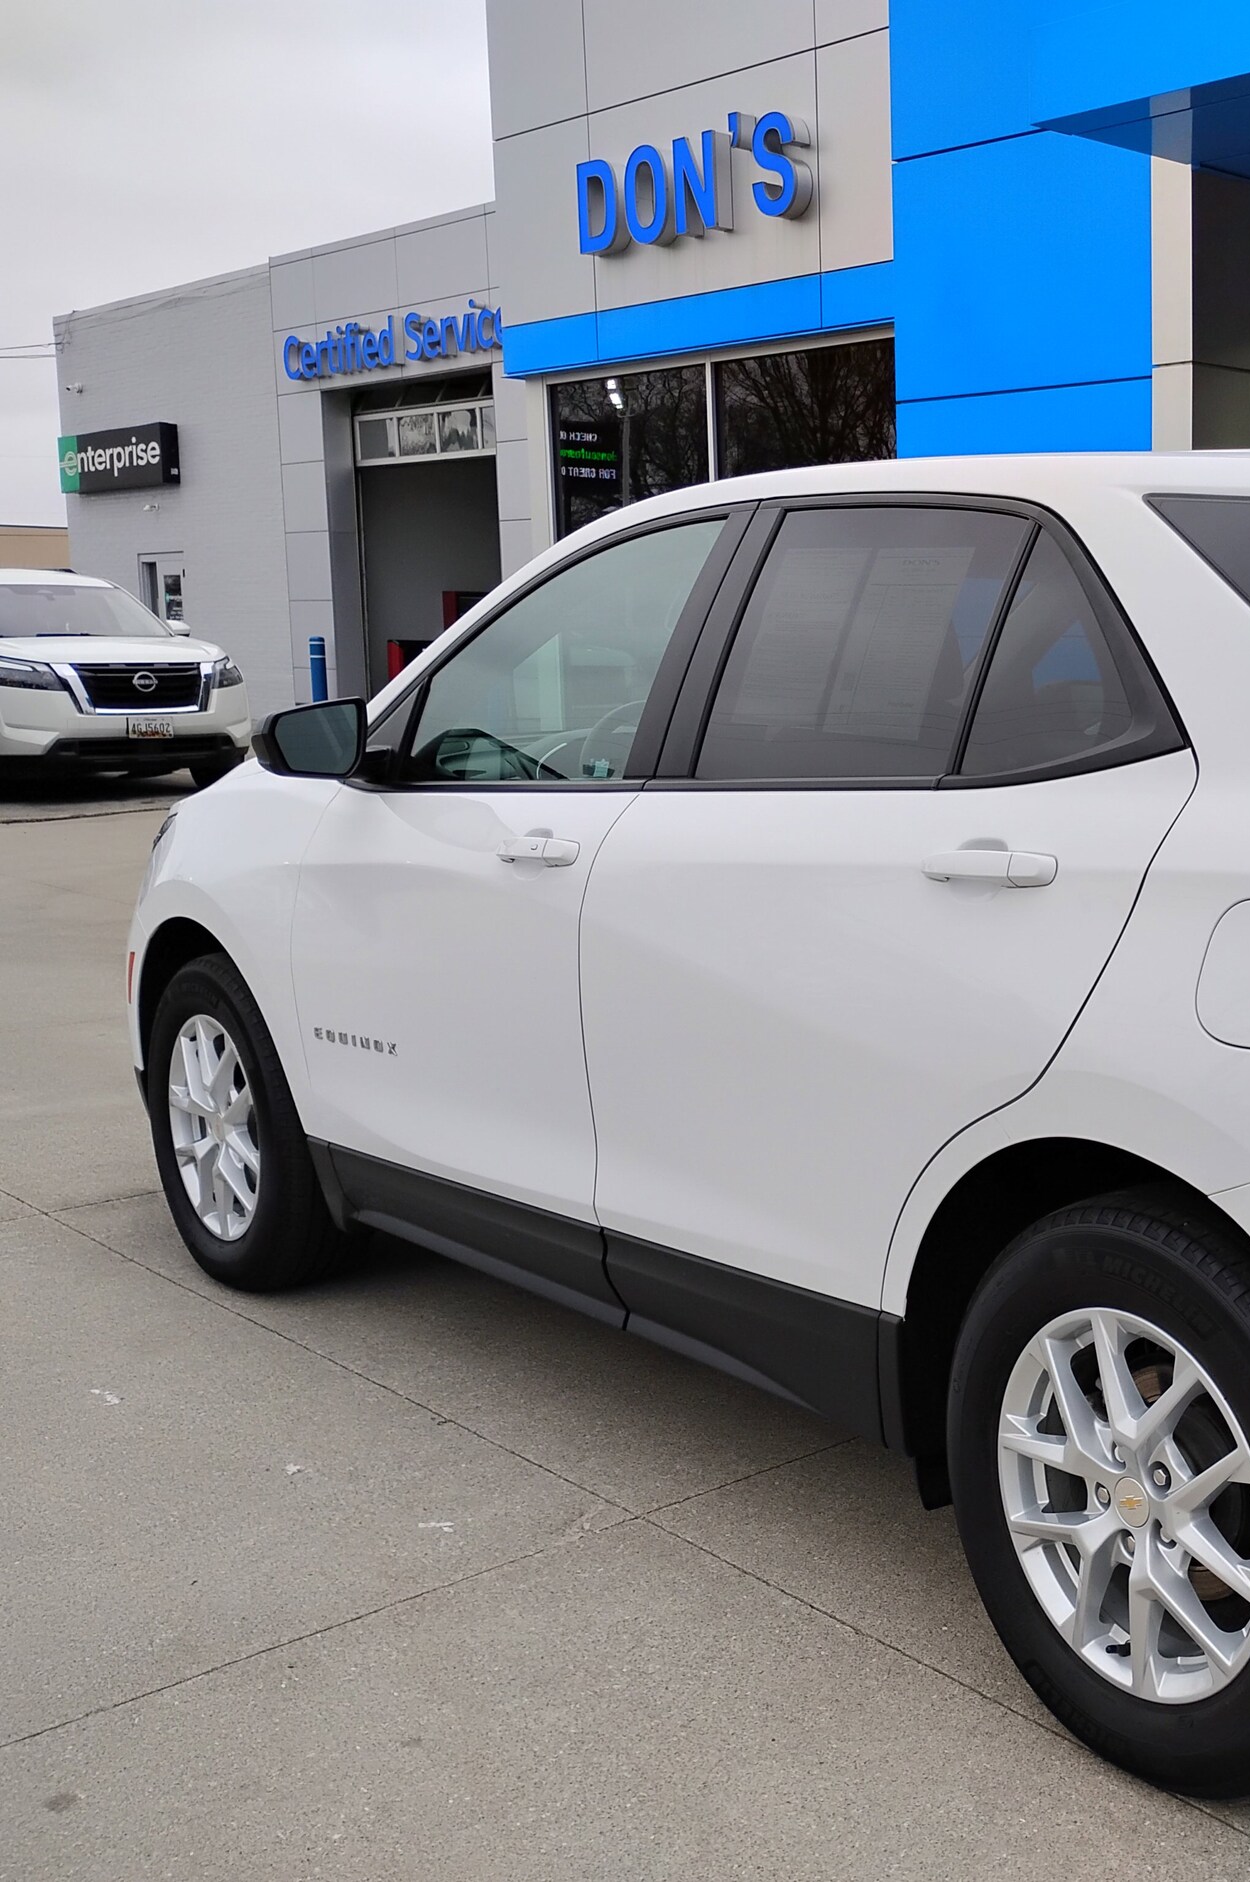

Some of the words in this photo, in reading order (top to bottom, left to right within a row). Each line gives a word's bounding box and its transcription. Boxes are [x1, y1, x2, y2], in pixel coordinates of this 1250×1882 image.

[577, 111, 803, 256] DON'S
[283, 315, 396, 381] Certified
[61, 436, 160, 477] enterprise
[314, 1027, 398, 1057] EQUINOX
